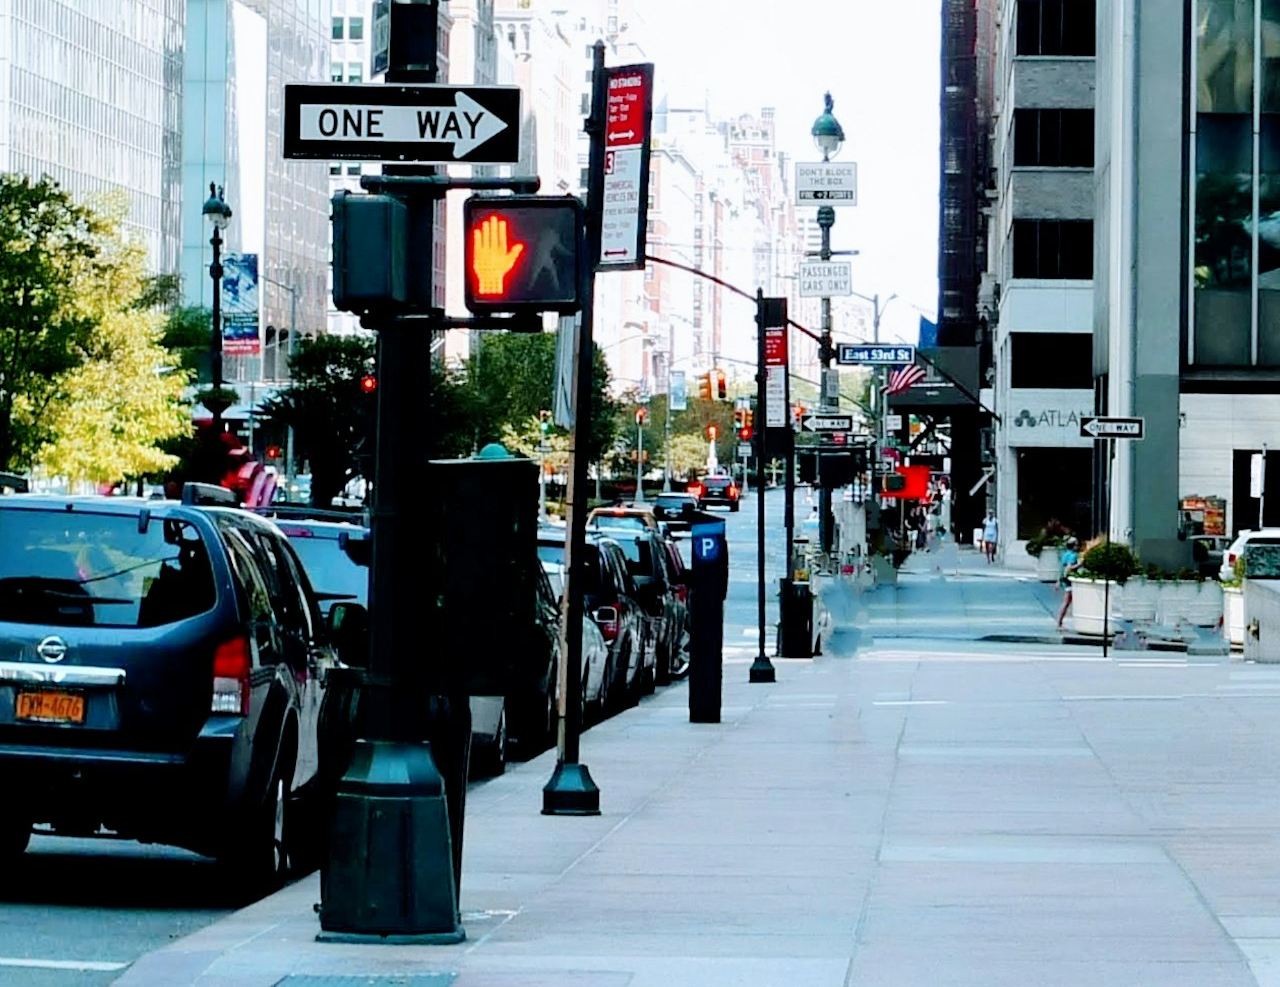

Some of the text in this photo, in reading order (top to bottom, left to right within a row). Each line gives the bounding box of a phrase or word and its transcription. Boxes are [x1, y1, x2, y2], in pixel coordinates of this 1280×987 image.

[319, 108, 484, 139] ONE WAY
[800, 168, 852, 177] DON'T BLOCK
[810, 178, 843, 186] THE BOX
[802, 266, 848, 277] PASSENGER
[802, 279, 848, 291] CARS ONLY
[845, 348, 910, 360] East 53rd St
[810, 418, 846, 428] ONE WAY
[1089, 423, 1136, 432] ONE WAY
[702, 538, 714, 556] P
